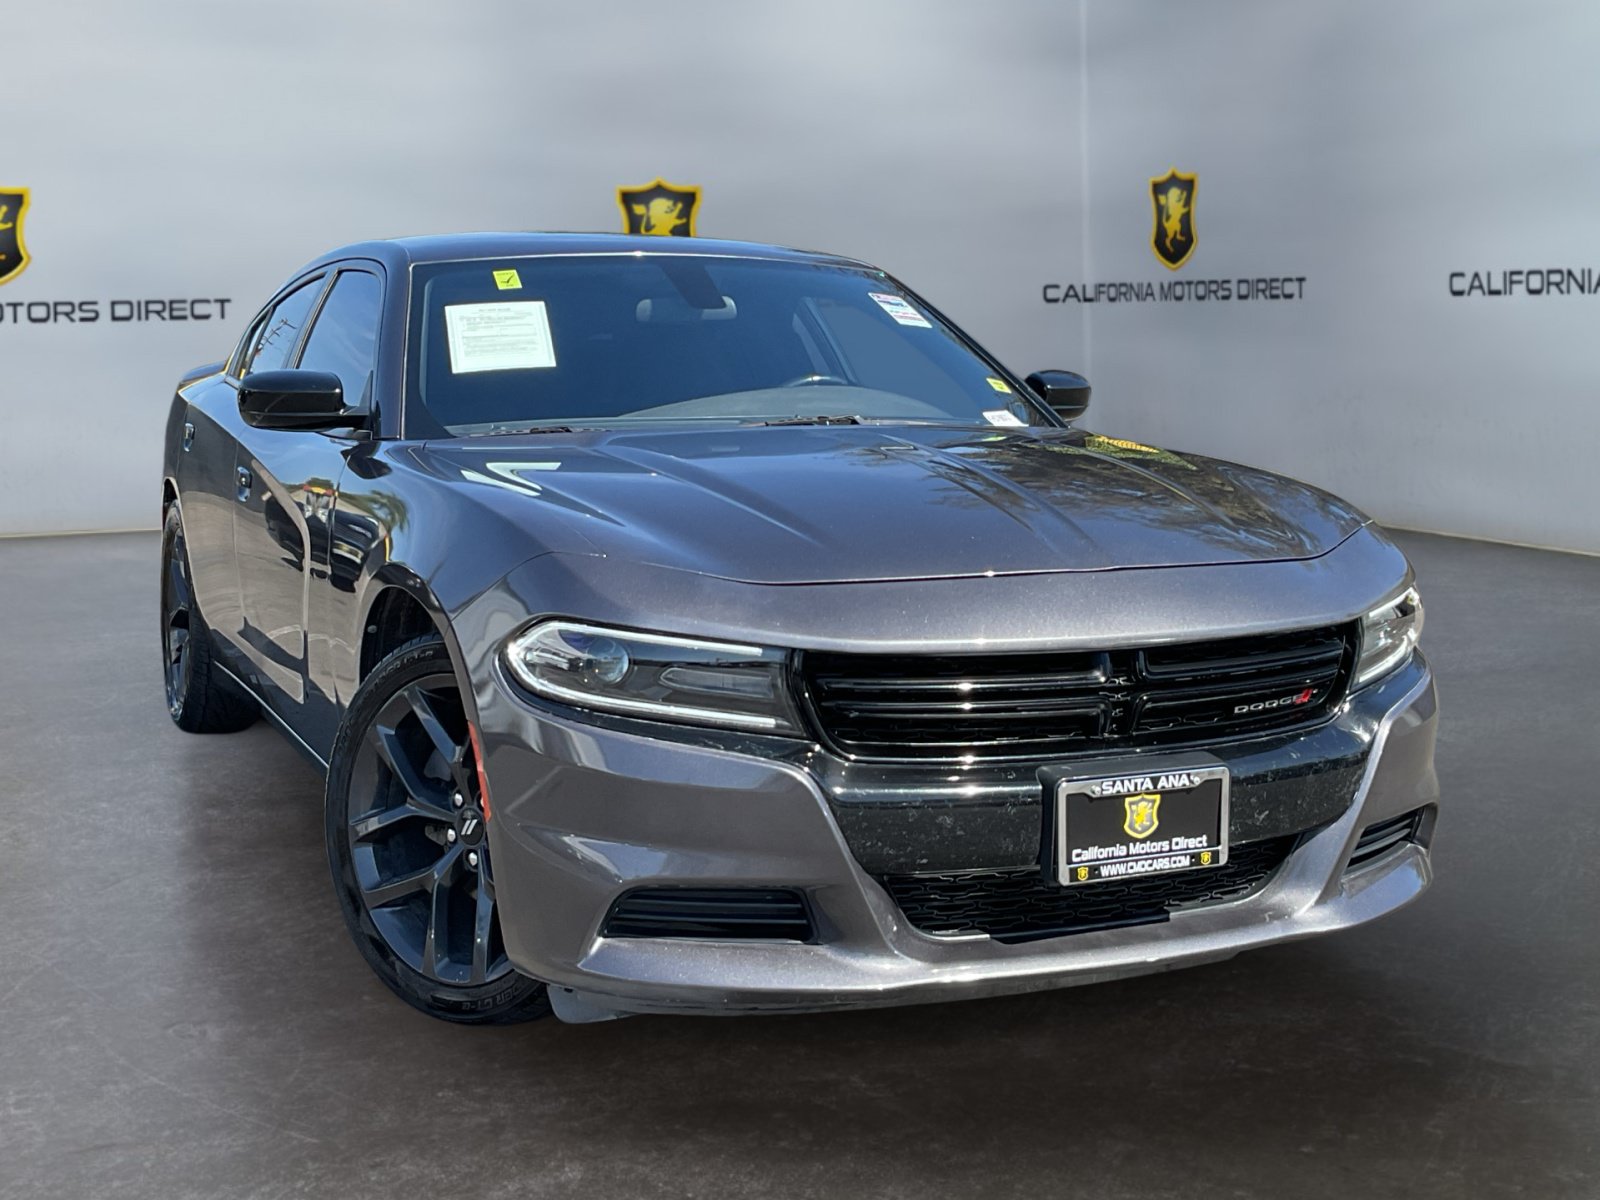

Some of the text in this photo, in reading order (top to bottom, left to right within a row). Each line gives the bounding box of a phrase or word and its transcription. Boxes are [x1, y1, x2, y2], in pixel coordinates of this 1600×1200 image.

[1043, 277, 1307, 303] CALIFORNIA MOTORS DIRECT
[0, 298, 231, 324] TORS DIRECT
[1101, 773, 1190, 795] SANTA ANA
[1072, 834, 1208, 862] California Motors Direct
